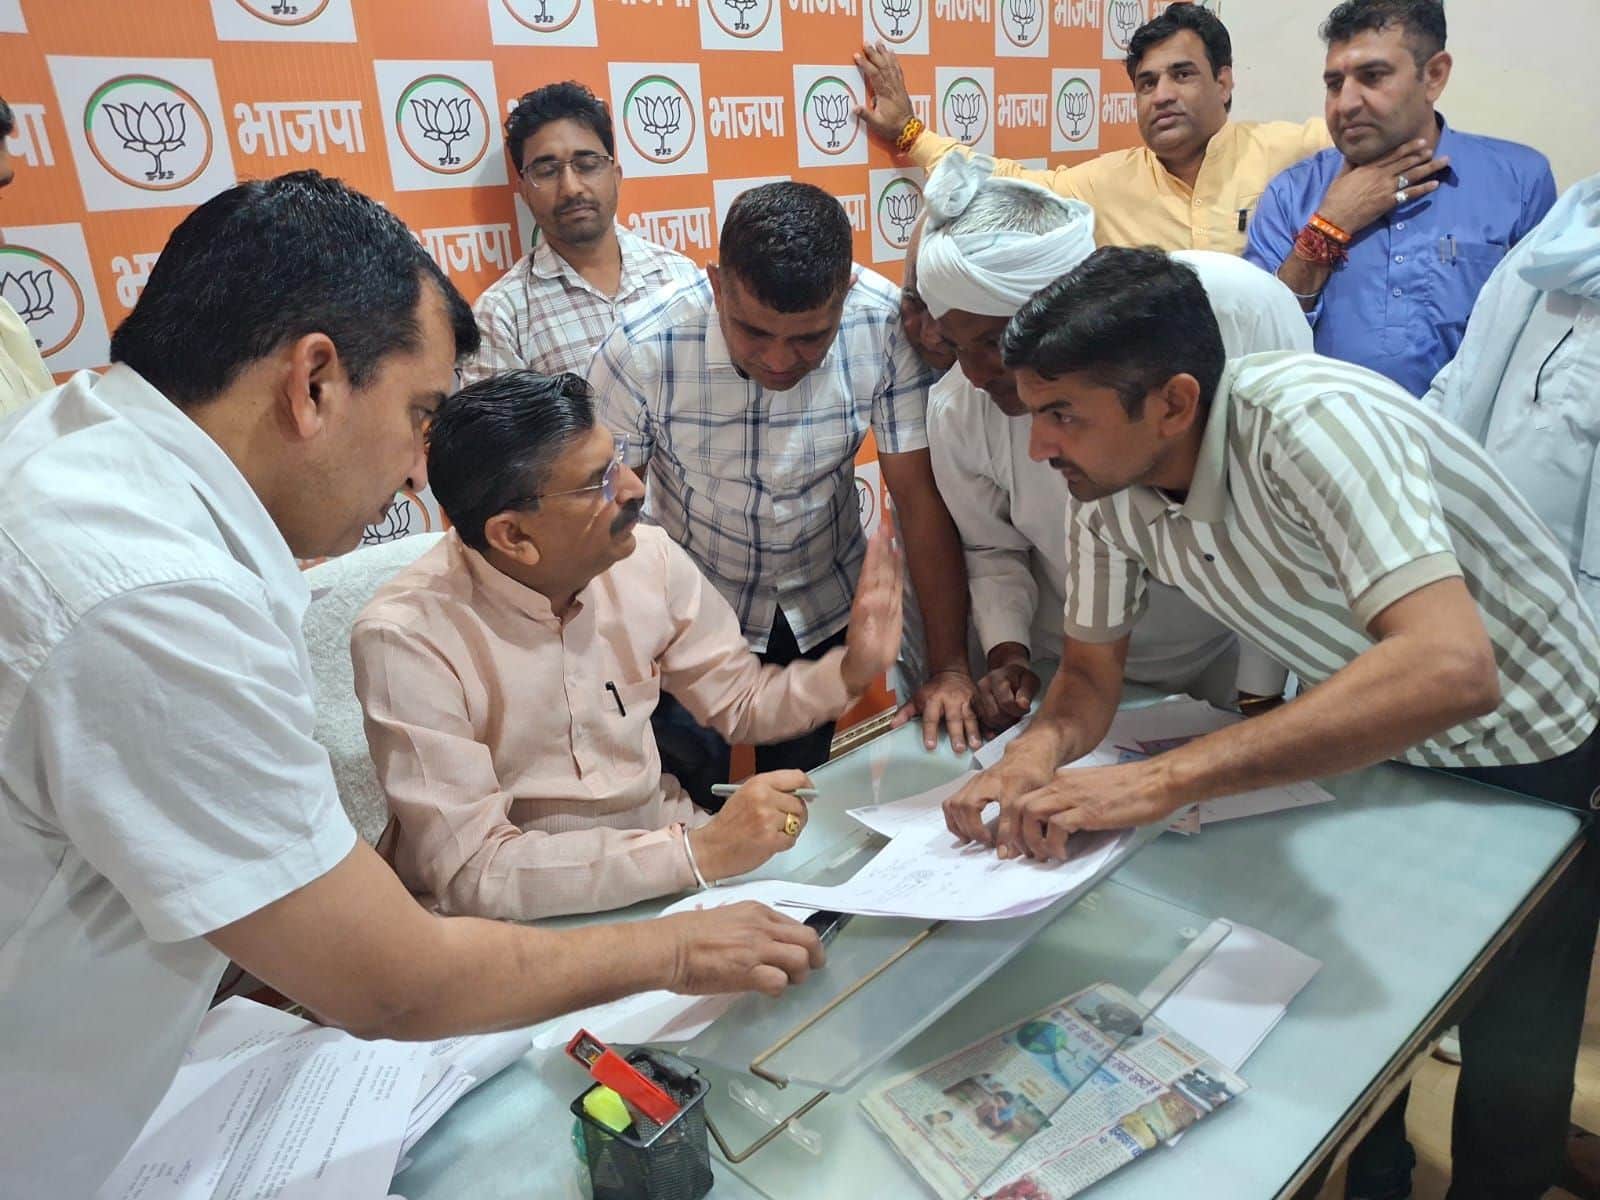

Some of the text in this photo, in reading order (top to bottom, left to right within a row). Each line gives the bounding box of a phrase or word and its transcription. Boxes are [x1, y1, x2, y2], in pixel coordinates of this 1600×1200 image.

[708, 95, 784, 139] भाजपा
[998, 93, 1048, 129] भाजपा
[1102, 92, 1138, 124] भाजप
[233, 100, 366, 157] भाजपा
